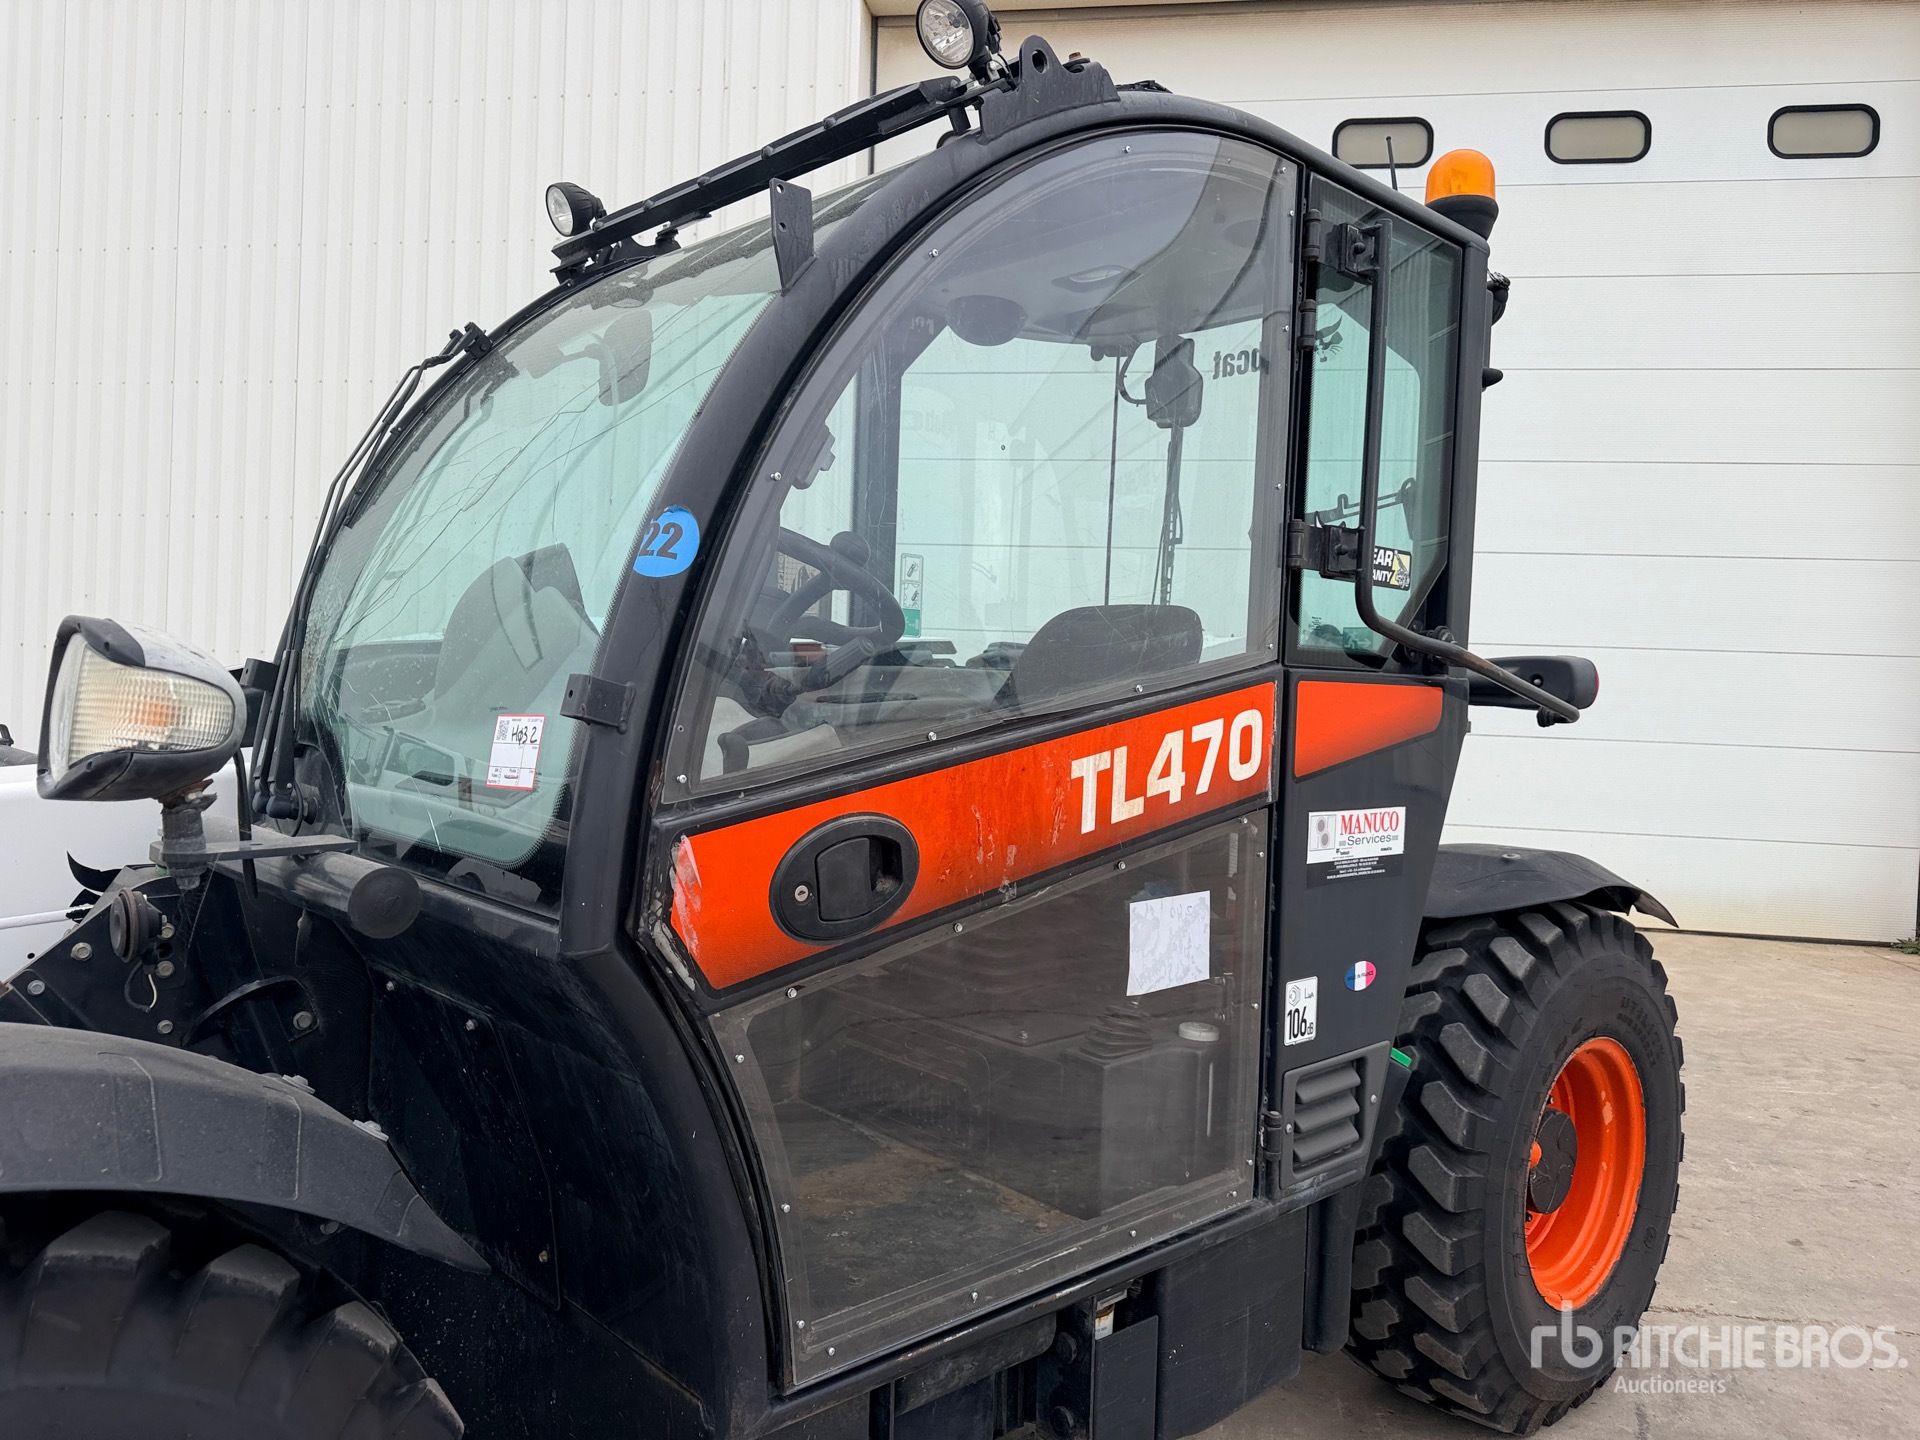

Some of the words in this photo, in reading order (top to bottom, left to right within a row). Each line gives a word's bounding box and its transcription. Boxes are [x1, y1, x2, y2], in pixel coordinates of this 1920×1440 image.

[1071, 708, 1263, 835] TL470
[1340, 810, 1400, 836] MANUCO
[1347, 834, 1392, 847] Services
[1287, 1005, 1307, 1040] 106
